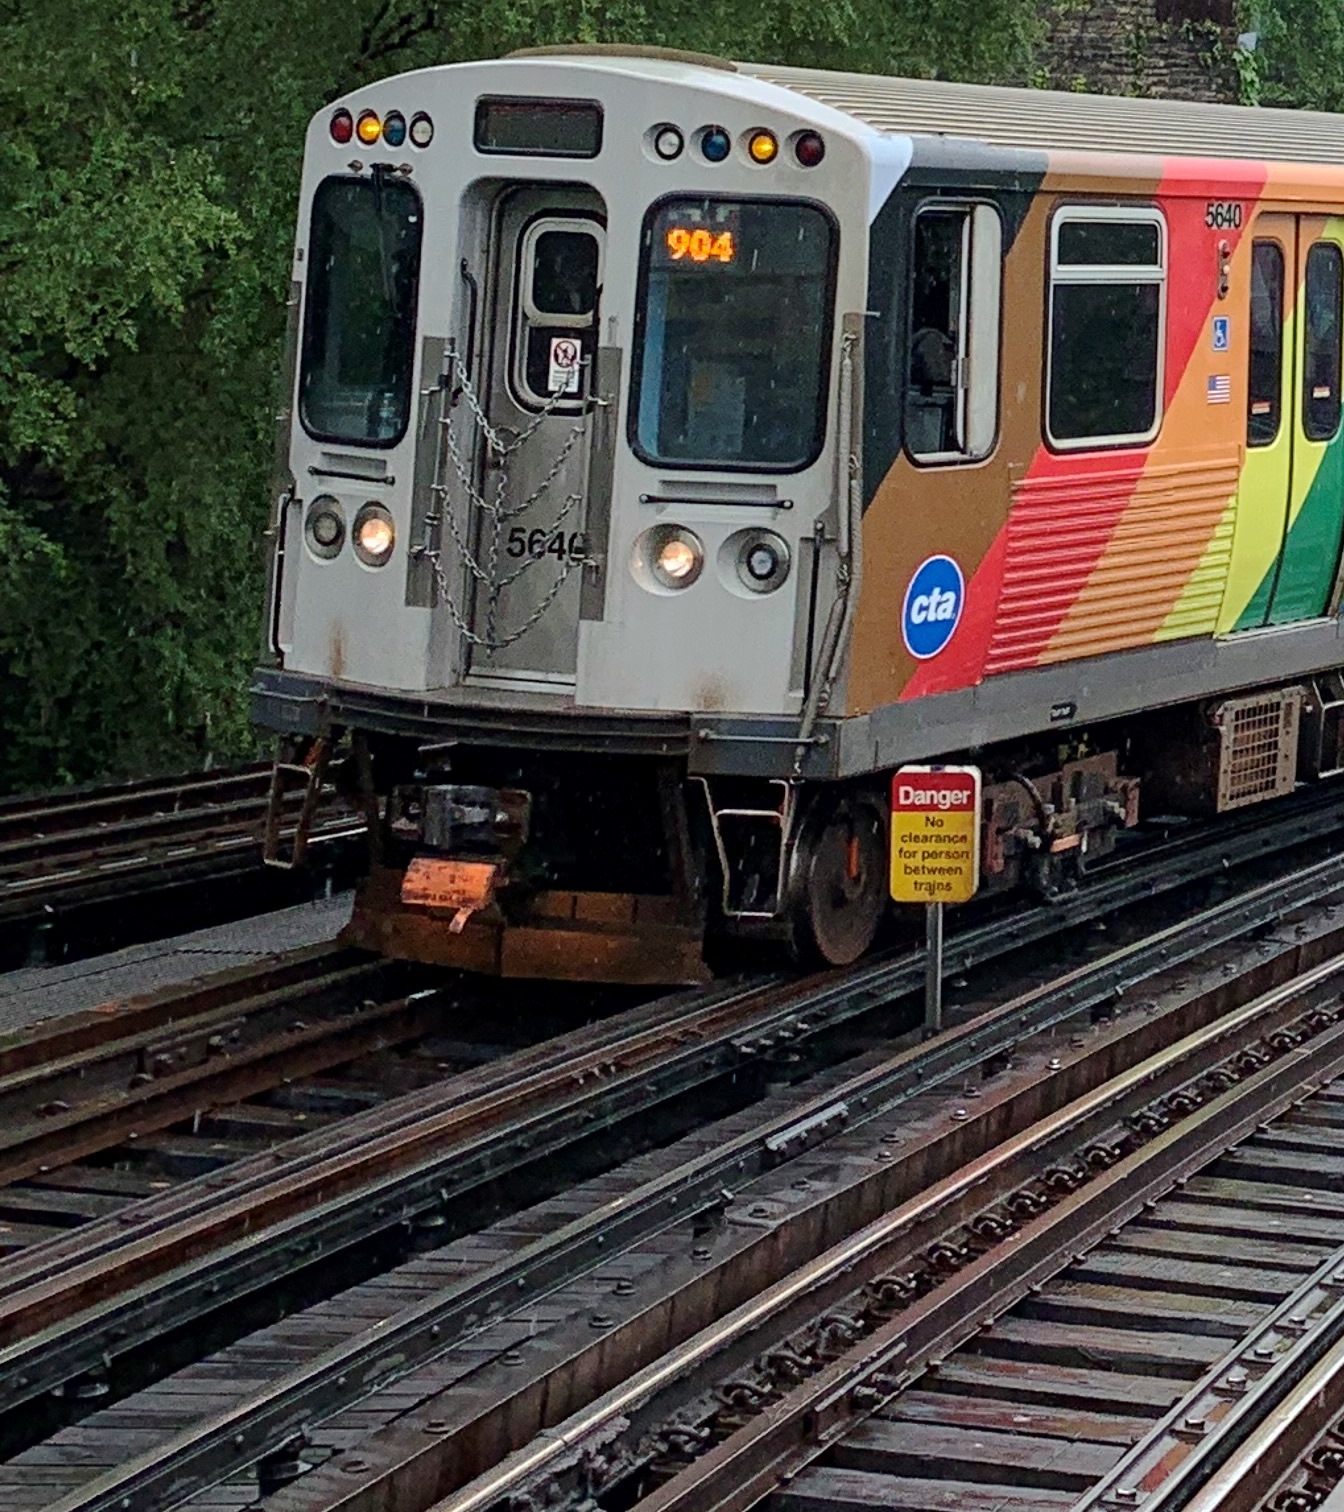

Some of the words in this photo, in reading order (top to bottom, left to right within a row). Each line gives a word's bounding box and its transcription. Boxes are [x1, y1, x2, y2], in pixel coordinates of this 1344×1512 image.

[1205, 202, 1242, 229] 5640
[667, 228, 734, 262] 904
[910, 587, 956, 624] cta
[899, 786, 972, 810] Danger
[925, 816, 944, 828] No
[900, 832, 968, 844] clearance
[898, 847, 918, 859] for
[921, 849, 969, 862] person
[903, 864, 963, 876] between
[913, 879, 953, 892] trains
